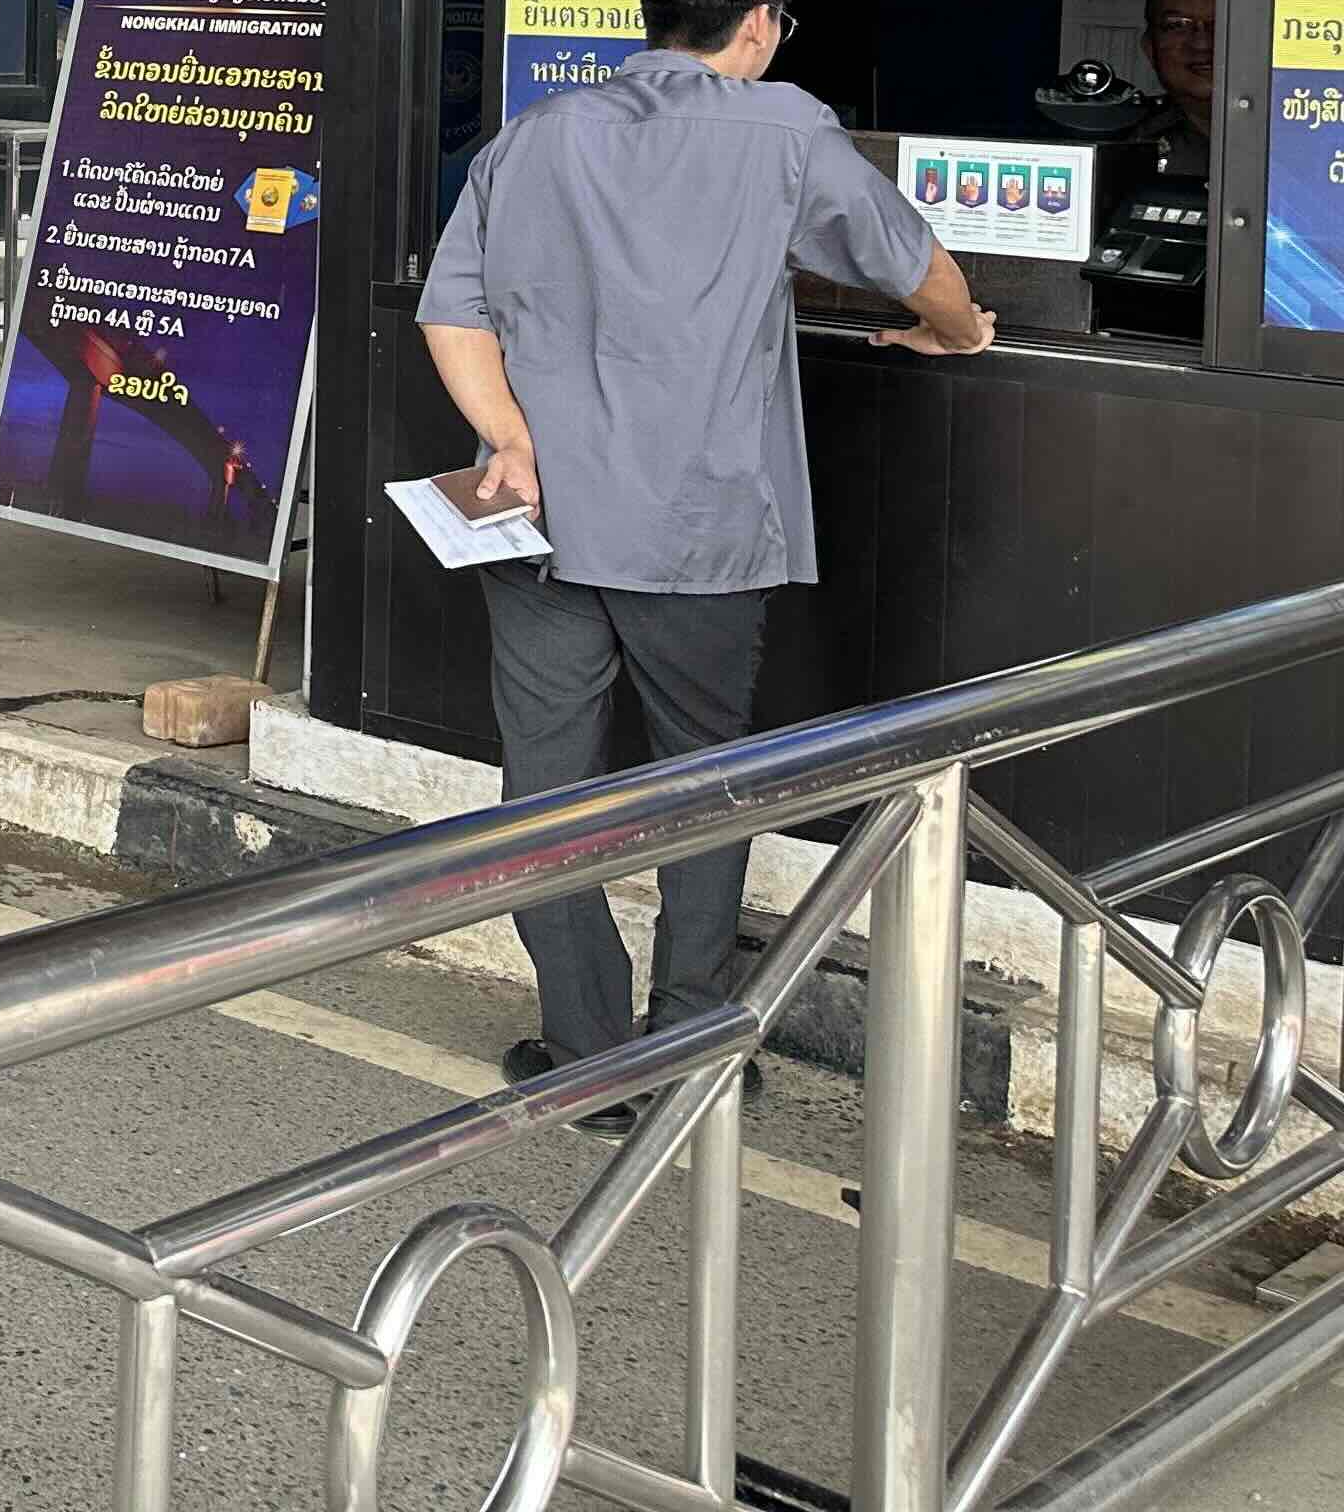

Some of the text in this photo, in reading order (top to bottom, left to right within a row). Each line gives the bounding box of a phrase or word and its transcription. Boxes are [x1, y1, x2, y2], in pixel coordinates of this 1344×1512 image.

[120, 15, 323, 37] NONGKHAI IMMIGRATION
[530, 50, 620, 85] หนังสือ
[1281, 86, 1344, 129] ໜັງສື
[104, 308, 131, 329] 4A
[157, 316, 185, 338] 5A
[107, 371, 190, 406] ຂອບໃຈ
